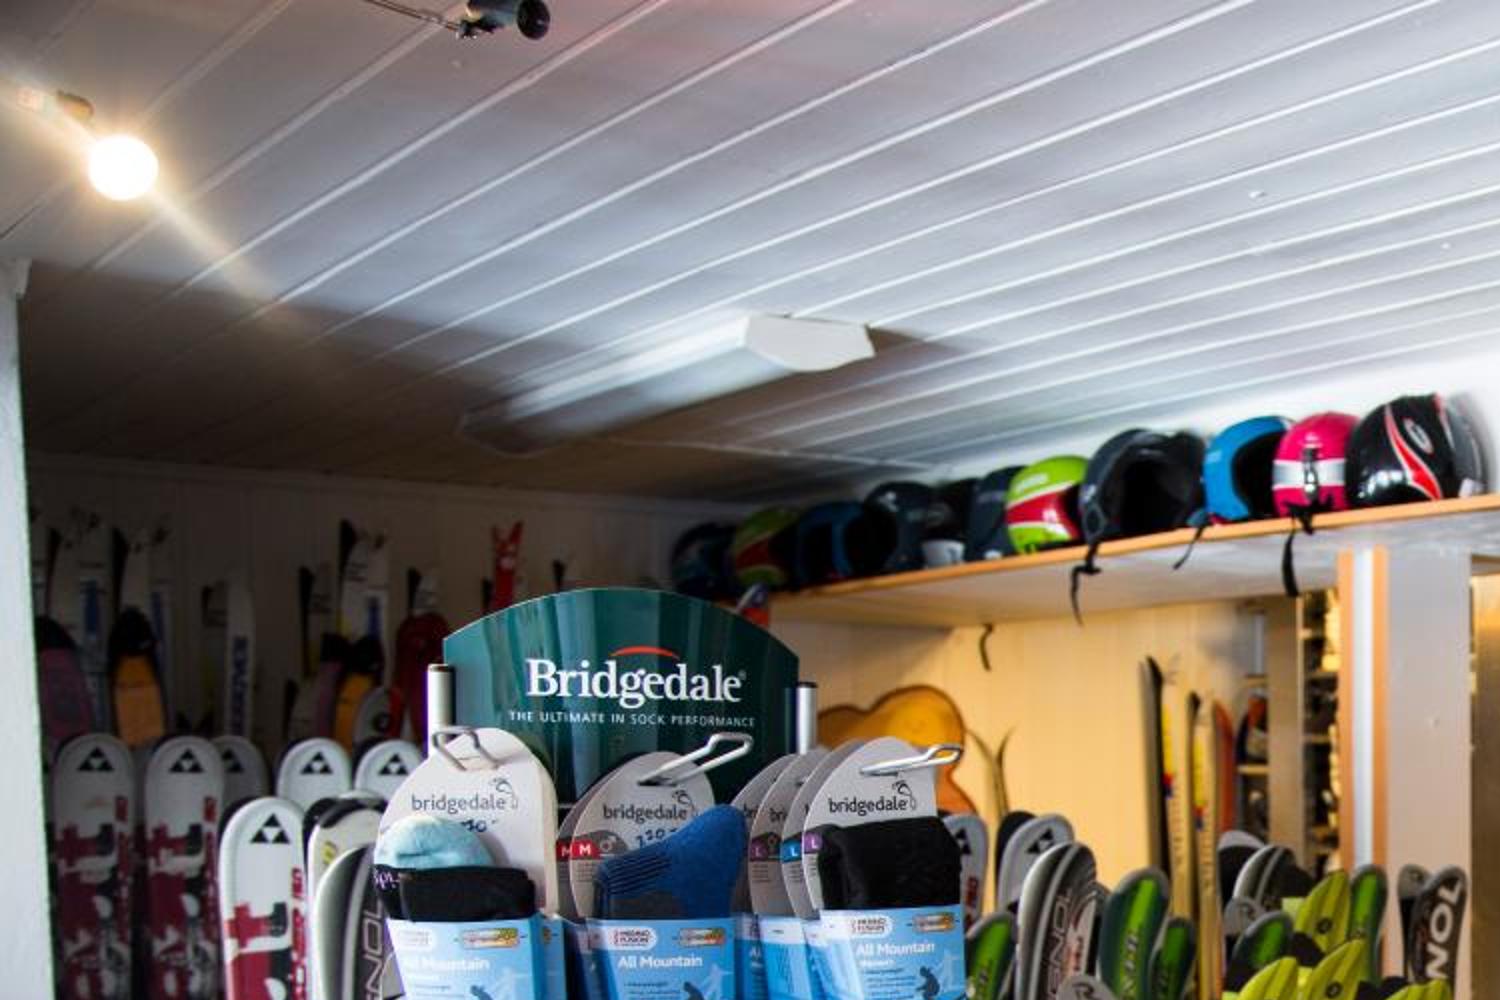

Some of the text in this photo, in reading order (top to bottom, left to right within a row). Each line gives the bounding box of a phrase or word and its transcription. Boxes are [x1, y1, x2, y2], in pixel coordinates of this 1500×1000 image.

[526, 658, 742, 709] Bridgedale
[509, 711, 755, 727] THE ULTIMATE IN SOCK PERFORMANCE
[411, 794, 506, 815] bridgedale
[828, 796, 908, 817] bridgedale
[602, 804, 688, 825] bridgedale
[579, 844, 591, 855] M
[856, 941, 936, 957] All Mountain
[419, 958, 491, 972] Mountain
[617, 952, 704, 970] All Mountain
